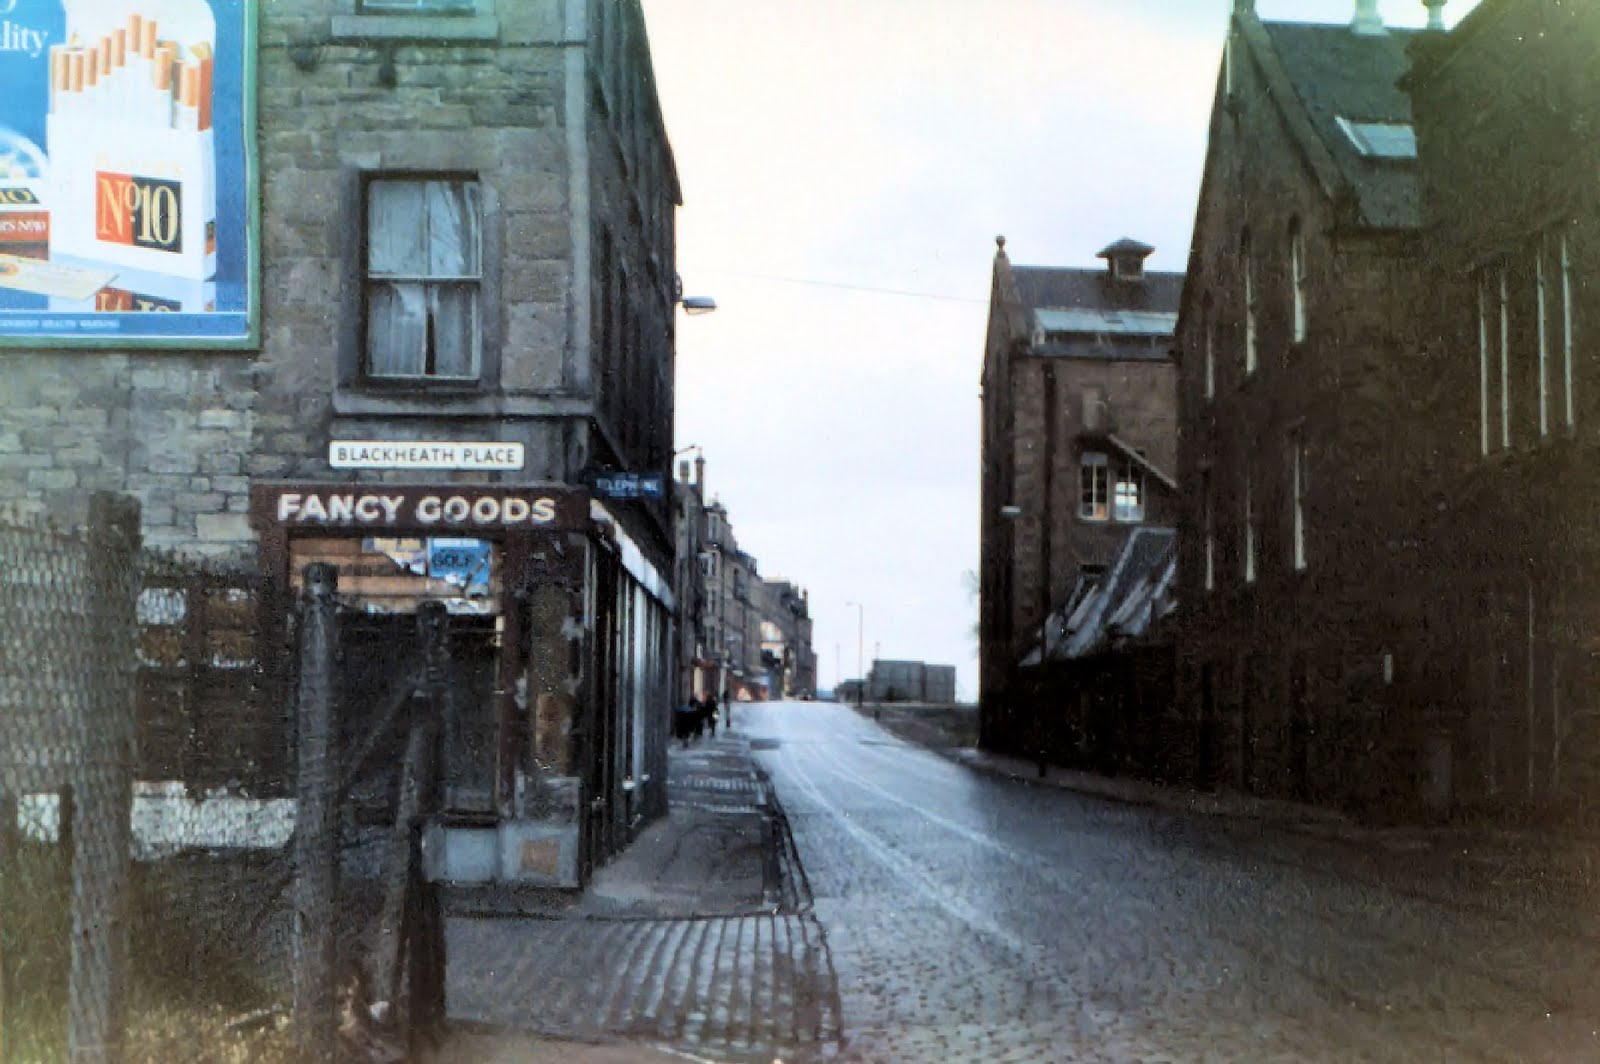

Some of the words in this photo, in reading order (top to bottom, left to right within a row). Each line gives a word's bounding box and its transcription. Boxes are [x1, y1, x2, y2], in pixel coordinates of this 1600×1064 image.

[337, 447, 455, 462] BLACKHEATH
[463, 448, 516, 463] PLACE
[277, 493, 405, 524] FANCY
[415, 495, 557, 525] GOODS
